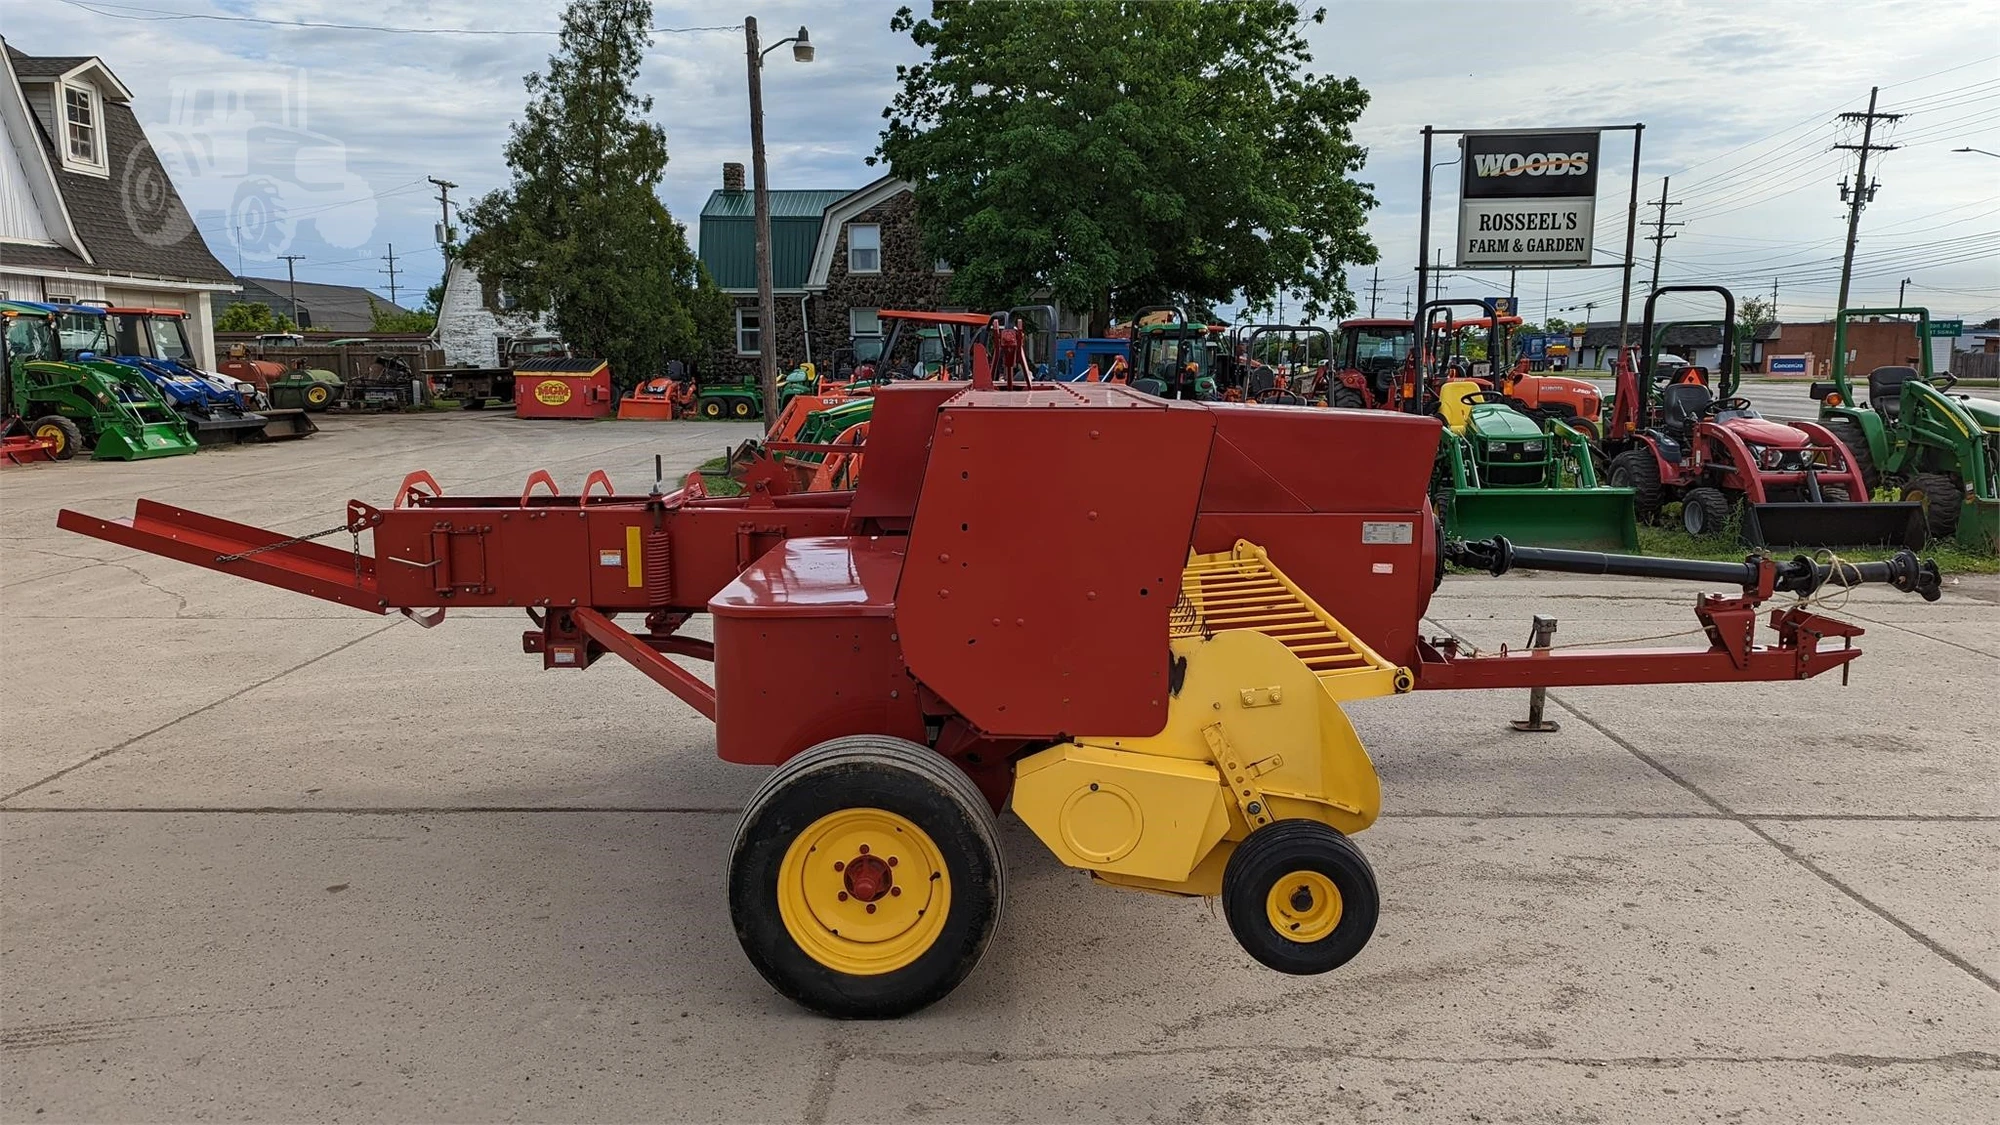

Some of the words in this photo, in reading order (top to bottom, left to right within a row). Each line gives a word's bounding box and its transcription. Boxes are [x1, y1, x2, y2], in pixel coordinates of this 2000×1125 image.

[1474, 151, 1589, 178] WOODS
[1479, 211, 1577, 231] ROSSEEL'S
[1468, 238, 1509, 253] FARM
[1512, 238, 1523, 252] &
[1526, 237, 1585, 252] GARDEN
